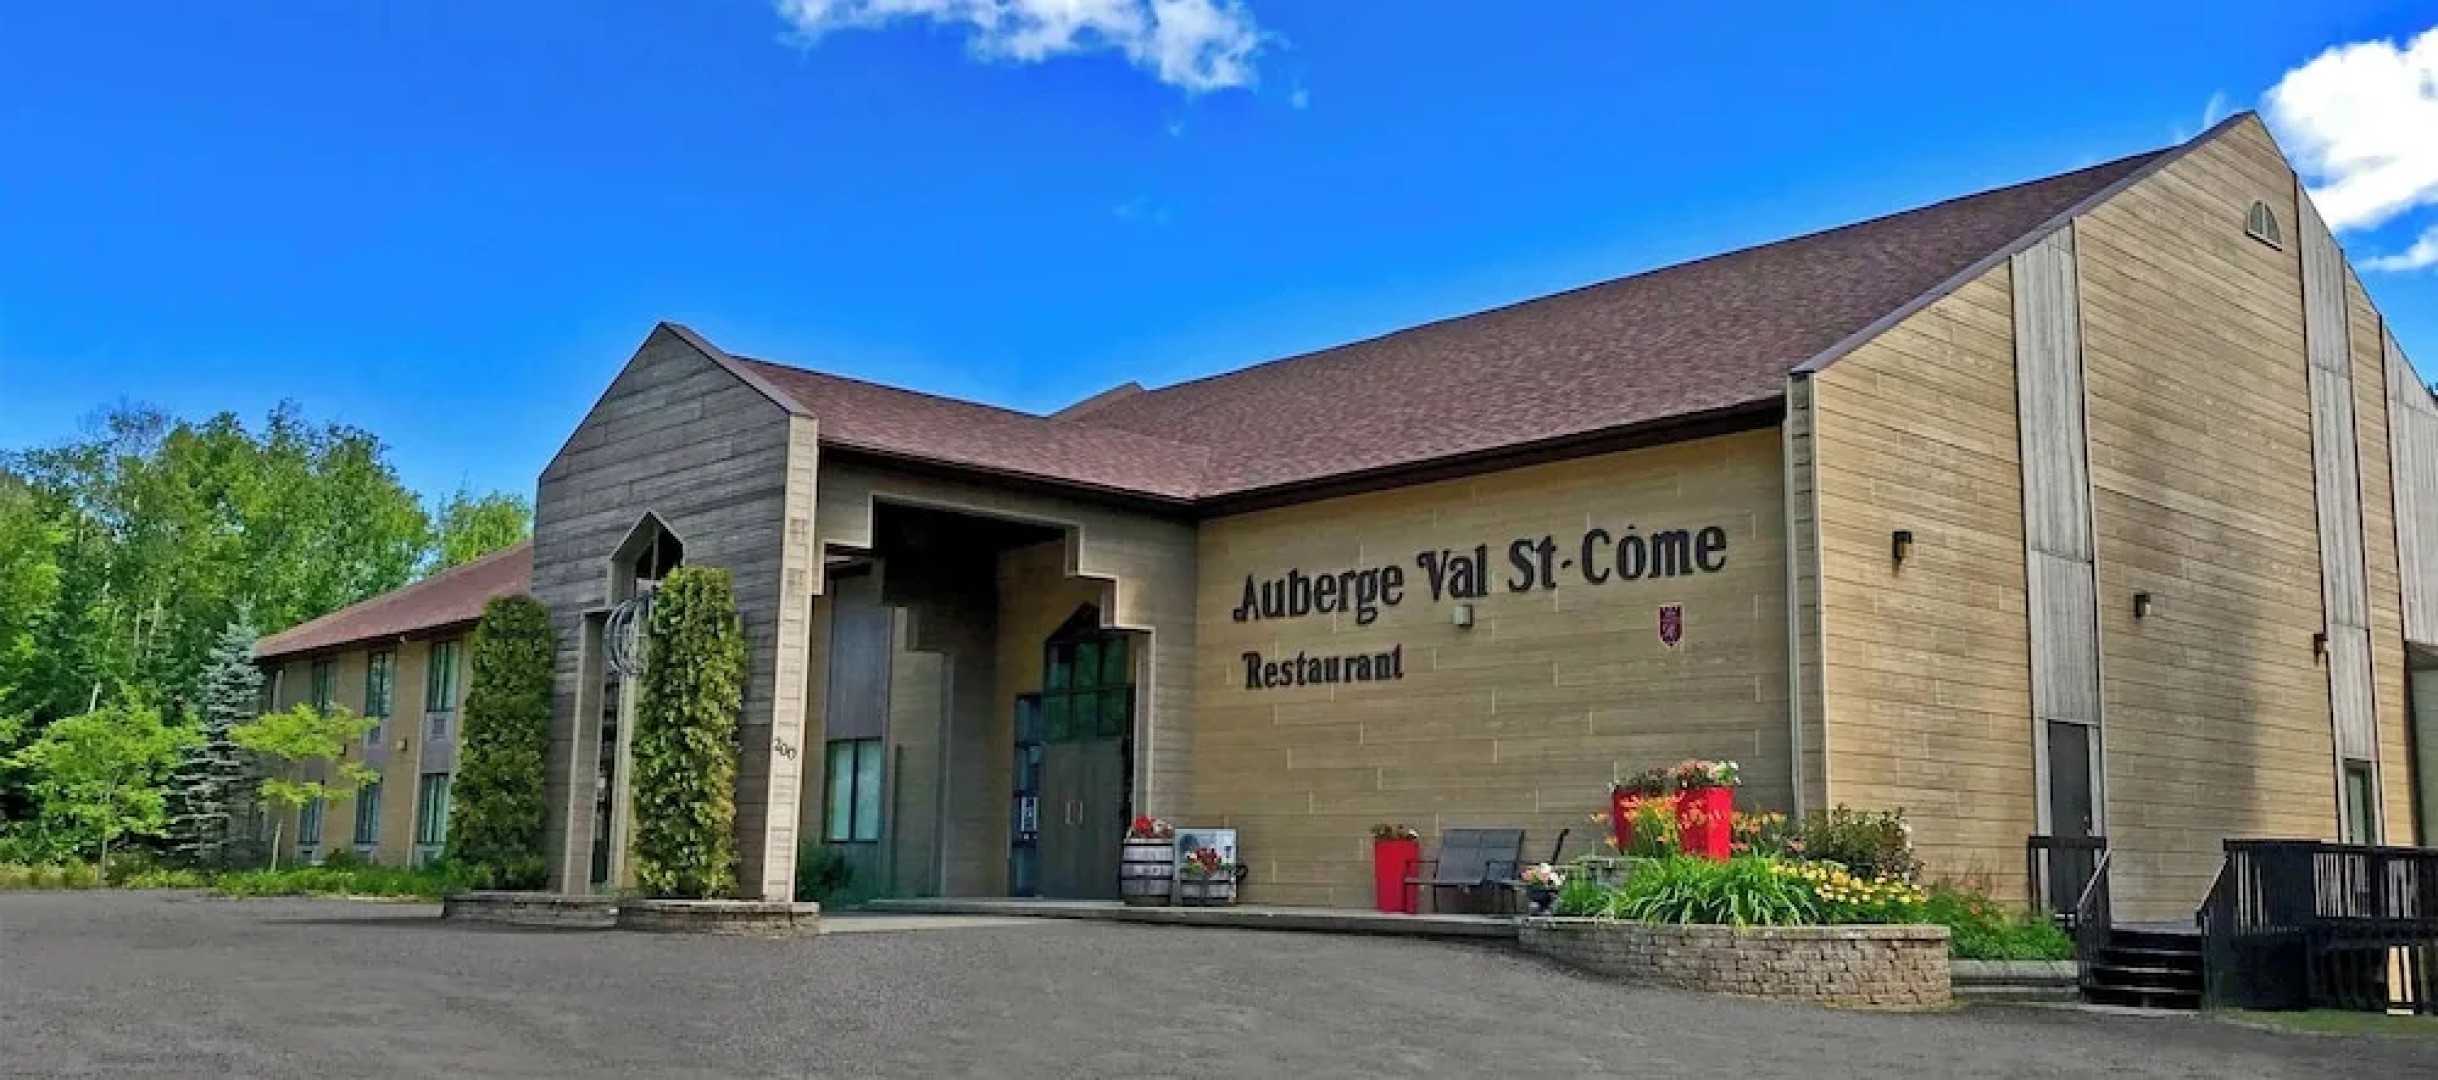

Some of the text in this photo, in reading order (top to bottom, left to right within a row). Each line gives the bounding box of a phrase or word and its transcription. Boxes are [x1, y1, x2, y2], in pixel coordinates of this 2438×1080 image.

[1233, 565, 1404, 625] Auberge
[1417, 543, 1488, 602] Val
[1241, 643, 1404, 690] Restaurant
[774, 736, 797, 760] 200
